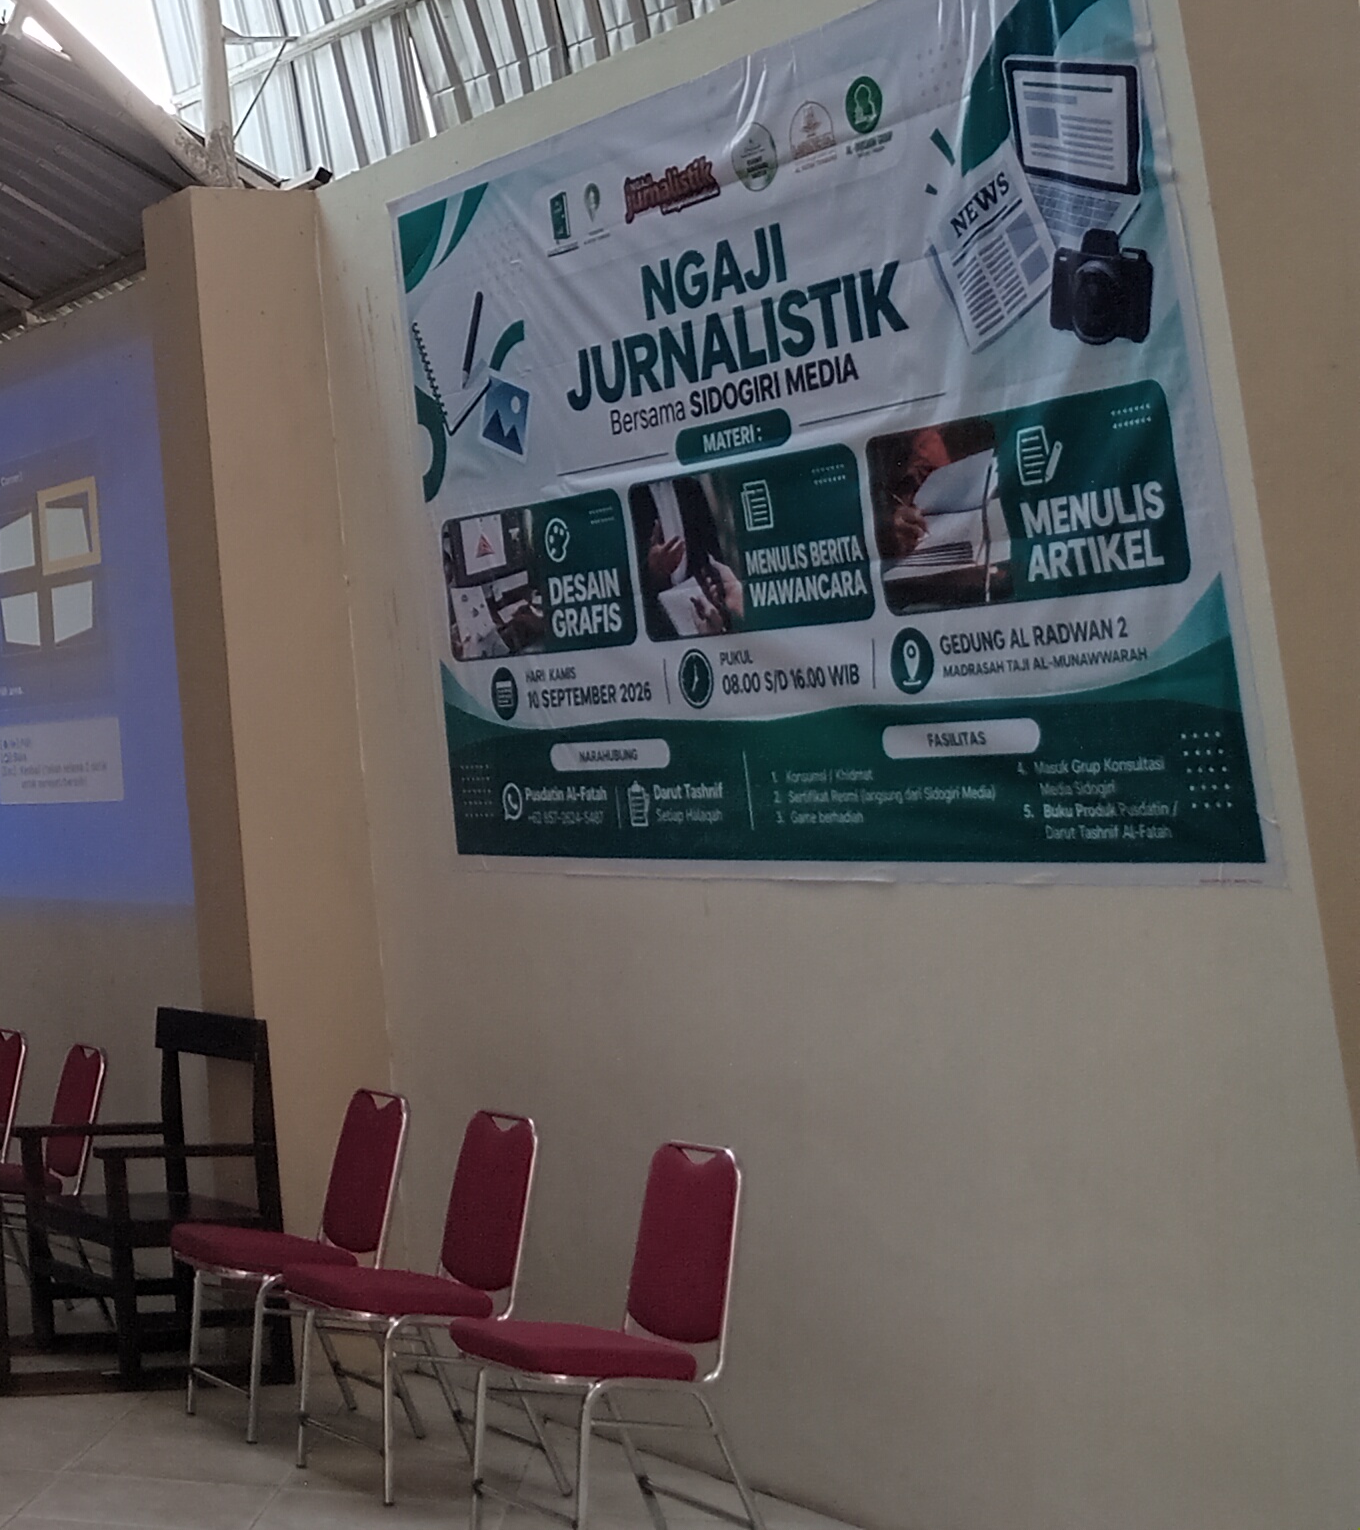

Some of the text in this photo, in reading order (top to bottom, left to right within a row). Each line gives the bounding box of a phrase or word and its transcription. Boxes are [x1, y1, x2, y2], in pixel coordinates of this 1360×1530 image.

[950, 171, 1010, 239] NEWS
[641, 223, 788, 320] NGAJI
[567, 260, 910, 411] JURNALISTIK
[610, 353, 860, 435] Bersama SIDOGIRI MEDIA
[702, 424, 755, 453] MATERI
[1019, 481, 1166, 539] MENULIS
[745, 535, 864, 576] MENULIS BERITA
[1028, 529, 1165, 582] ARTIKEL
[548, 568, 620, 606] DESAIN
[749, 569, 867, 608] WAWANCARA
[551, 602, 622, 638] GRAFIS
[939, 616, 1129, 655] GEDUNG AL RADWAN 2
[549, 666, 577, 682] KAMIS
[719, 649, 754, 666] PUKUL
[942, 660, 1004, 678] MADRASAH
[1032, 647, 1148, 670] AL-MUNAWWARAH
[527, 681, 652, 709] 10 SEPTEMBER 2026
[722, 663, 860, 695] 08.00 S/D 16.00 WIB
[927, 730, 986, 747] FASILITAS
[578, 749, 639, 763] NARAHUBUNG
[1071, 759, 1100, 775] Grup
[1103, 755, 1165, 772] Konsultasi
[653, 782, 723, 800] Darut Tashnif
[1023, 804, 1034, 818] 5.
[1043, 803, 1073, 818] Buku
[1074, 802, 1117, 817] Produk
